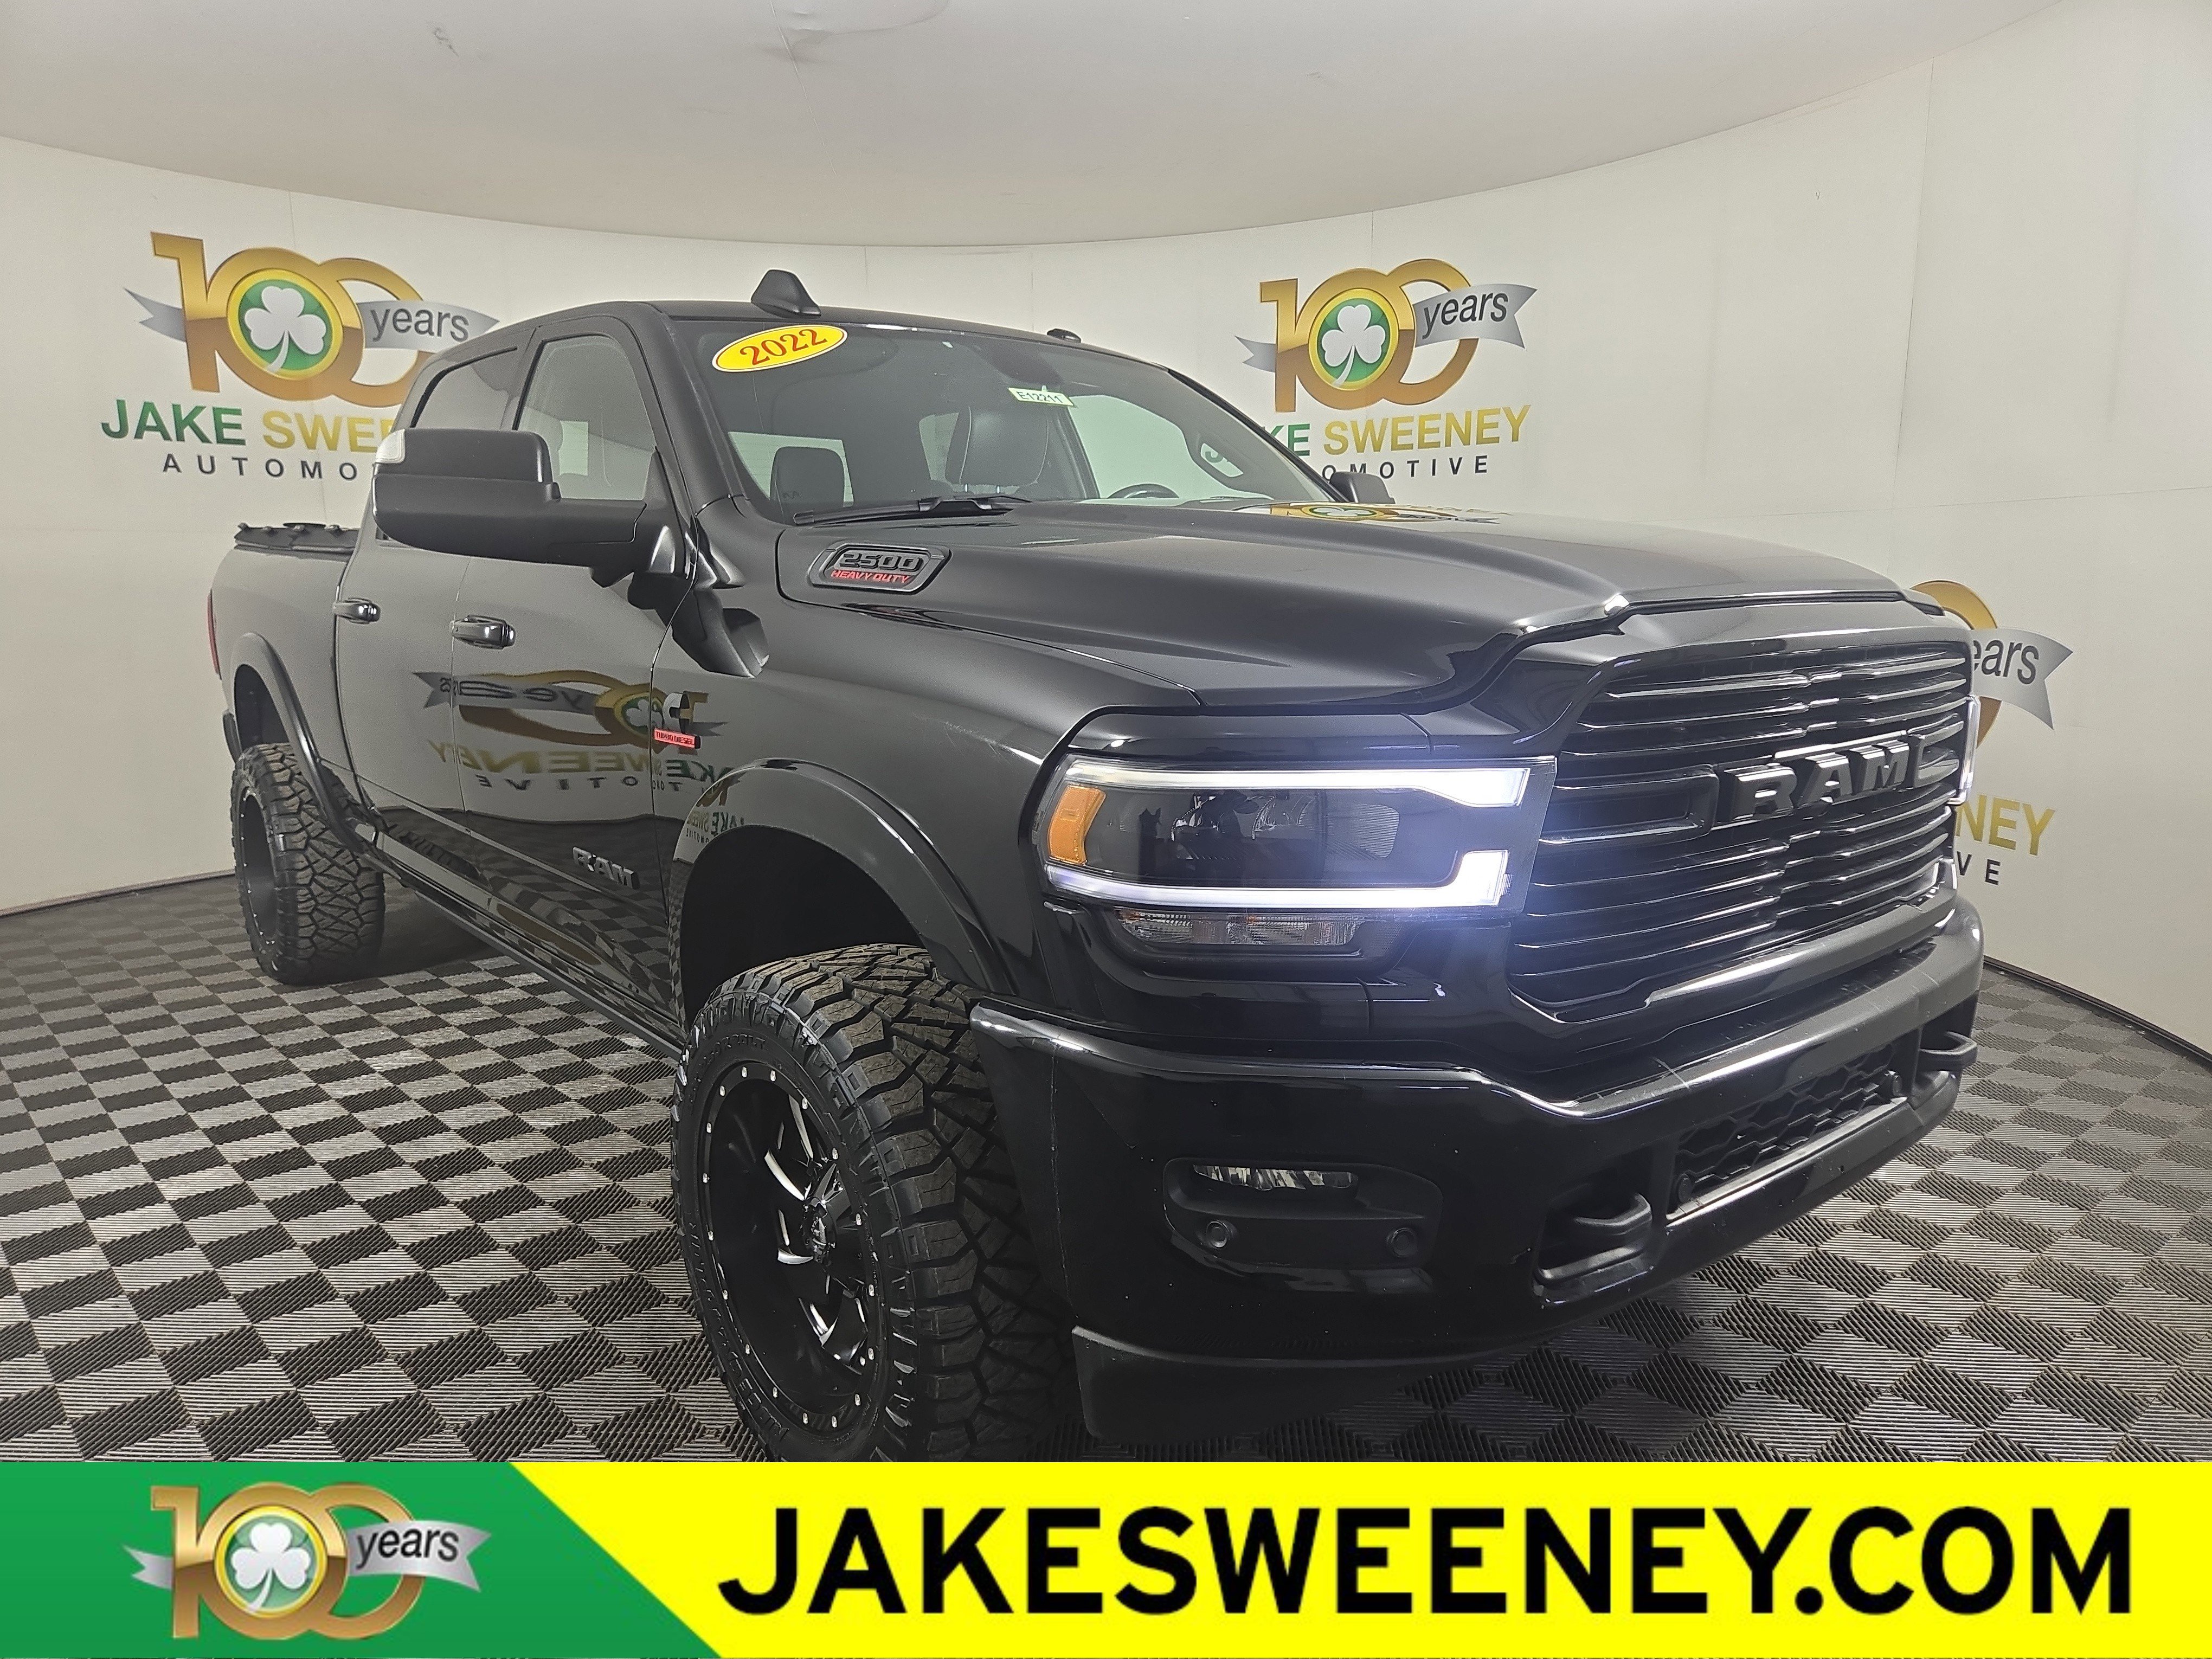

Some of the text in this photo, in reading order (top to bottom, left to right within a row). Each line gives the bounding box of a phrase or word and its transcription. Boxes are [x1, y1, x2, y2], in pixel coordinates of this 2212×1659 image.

[370, 305, 470, 343] years
[1422, 288, 1509, 340] years
[740, 329, 828, 365] 2022
[1016, 391, 1063, 403] E12211
[101, 398, 246, 447] JAKE
[1323, 404, 1531, 455] SWEENEY
[163, 452, 357, 481] AUTOMO
[1322, 454, 1489, 481] OMOTIVE
[831, 569, 911, 584] HEAVY DUTY
[839, 552, 923, 572] 2500
[1716, 738, 1910, 821] RAM
[573, 846, 639, 890] RAM
